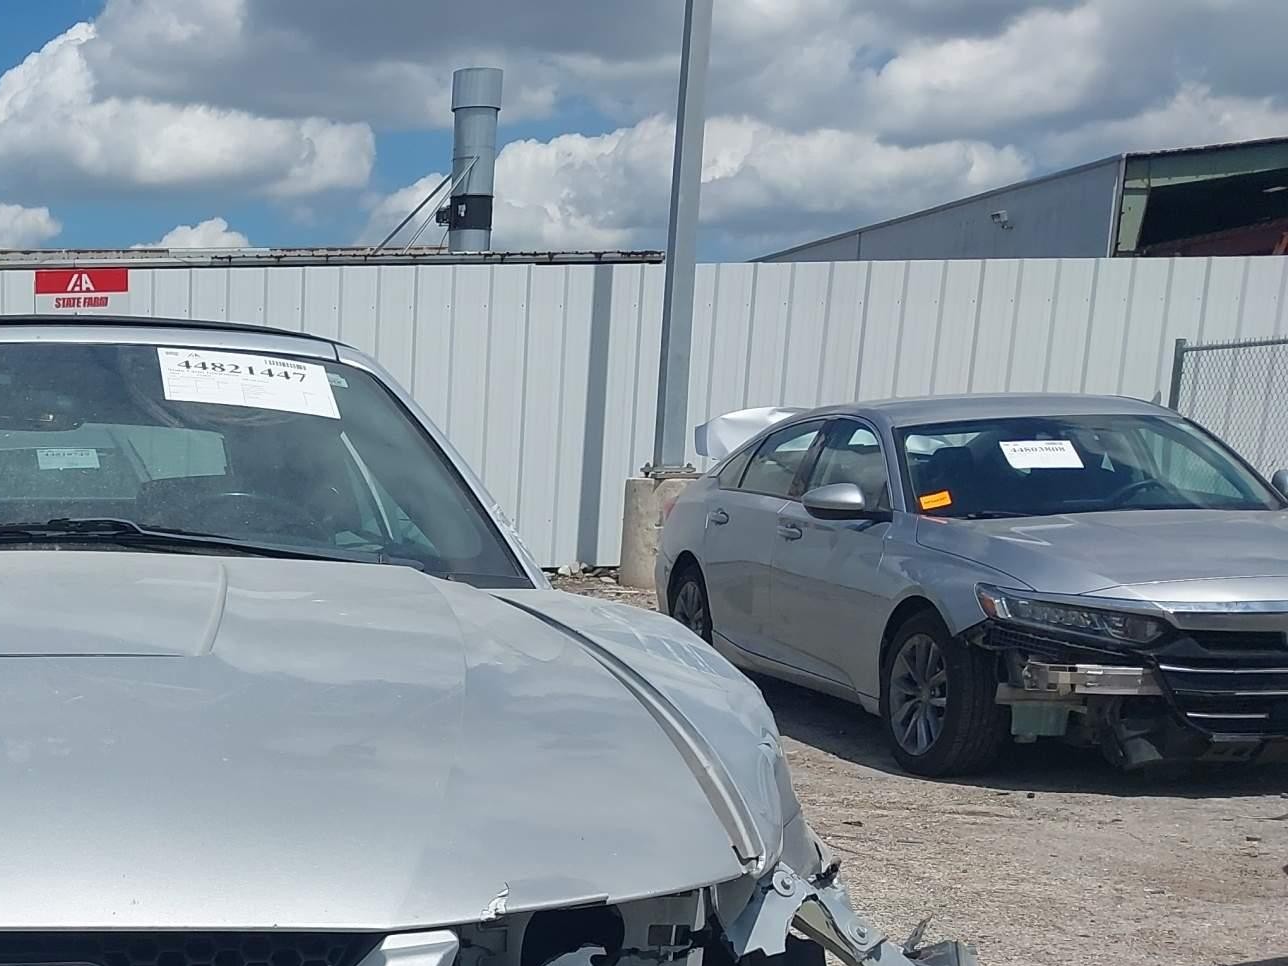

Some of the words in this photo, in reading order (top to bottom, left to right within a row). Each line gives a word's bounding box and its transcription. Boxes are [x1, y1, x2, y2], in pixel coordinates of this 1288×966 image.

[54, 297, 82, 308] STATE
[82, 296, 109, 308] FARM
[177, 360, 307, 382] 44821447
